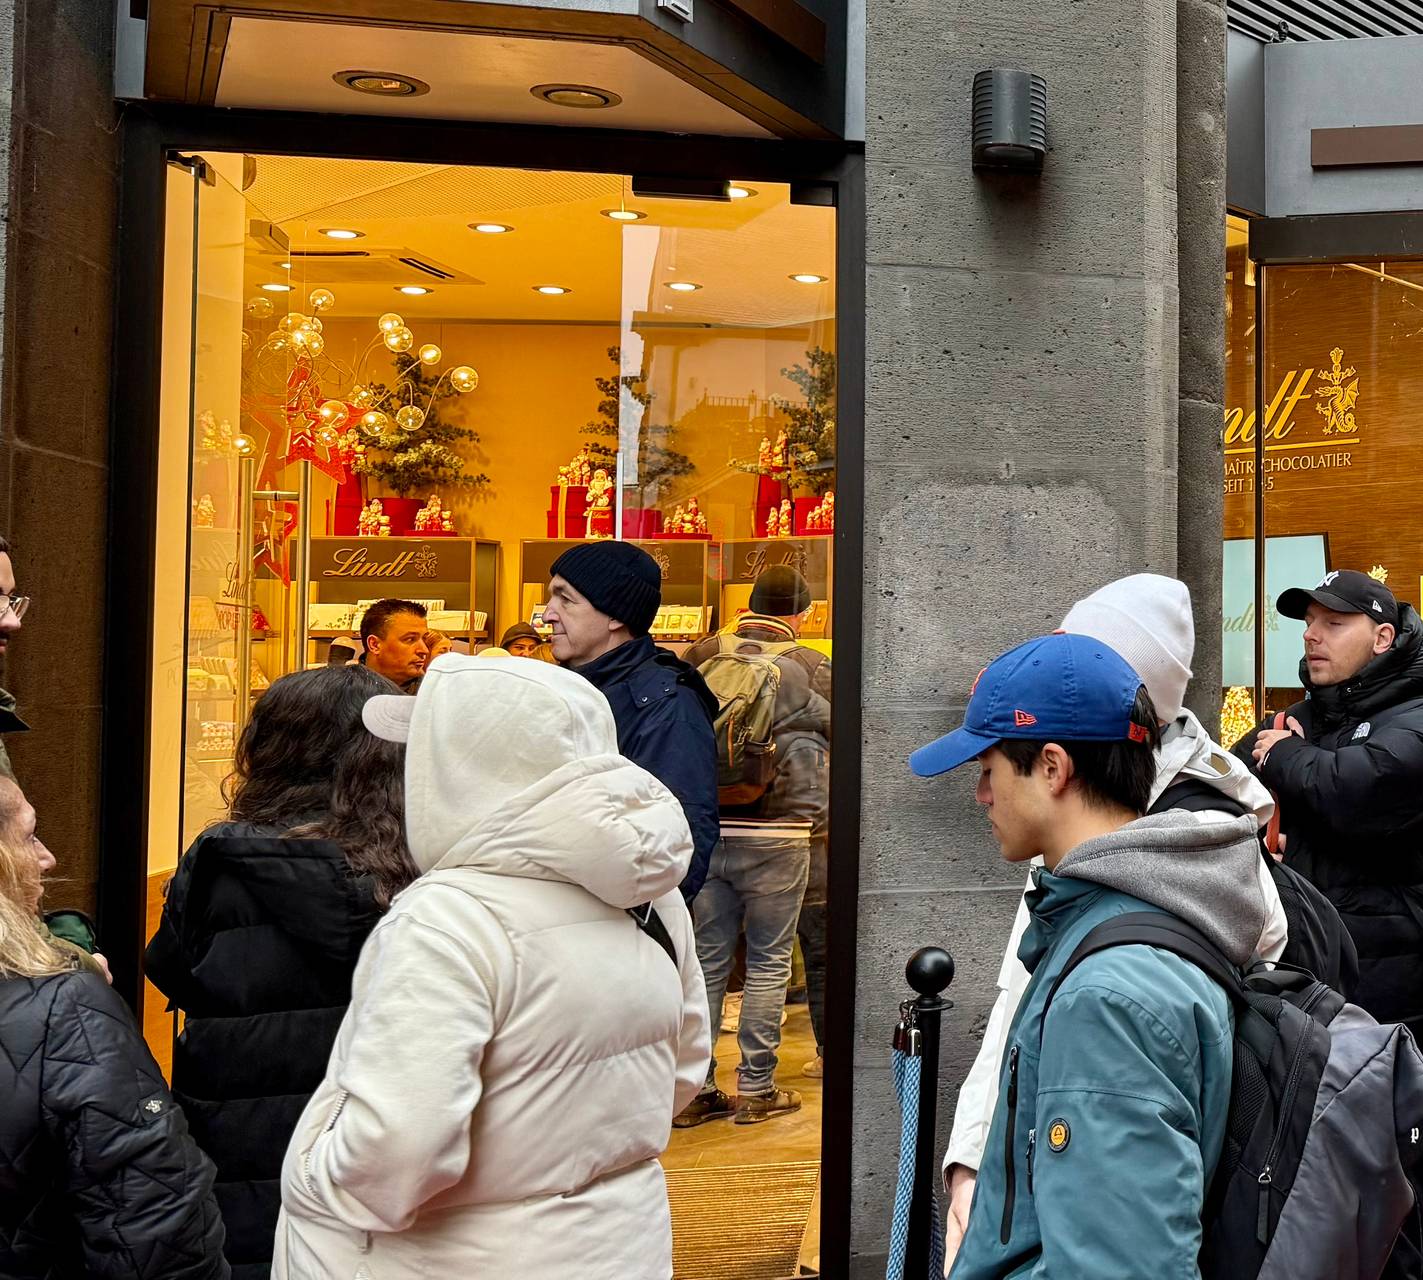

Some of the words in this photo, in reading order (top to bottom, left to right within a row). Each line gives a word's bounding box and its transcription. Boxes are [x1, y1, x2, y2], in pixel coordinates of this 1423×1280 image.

[1223, 368, 1315, 444] ndt
[1223, 458, 1256, 476] AÎTR
[1263, 452, 1352, 473] CHOCOLATIER
[322, 547, 416, 577] Lindt
